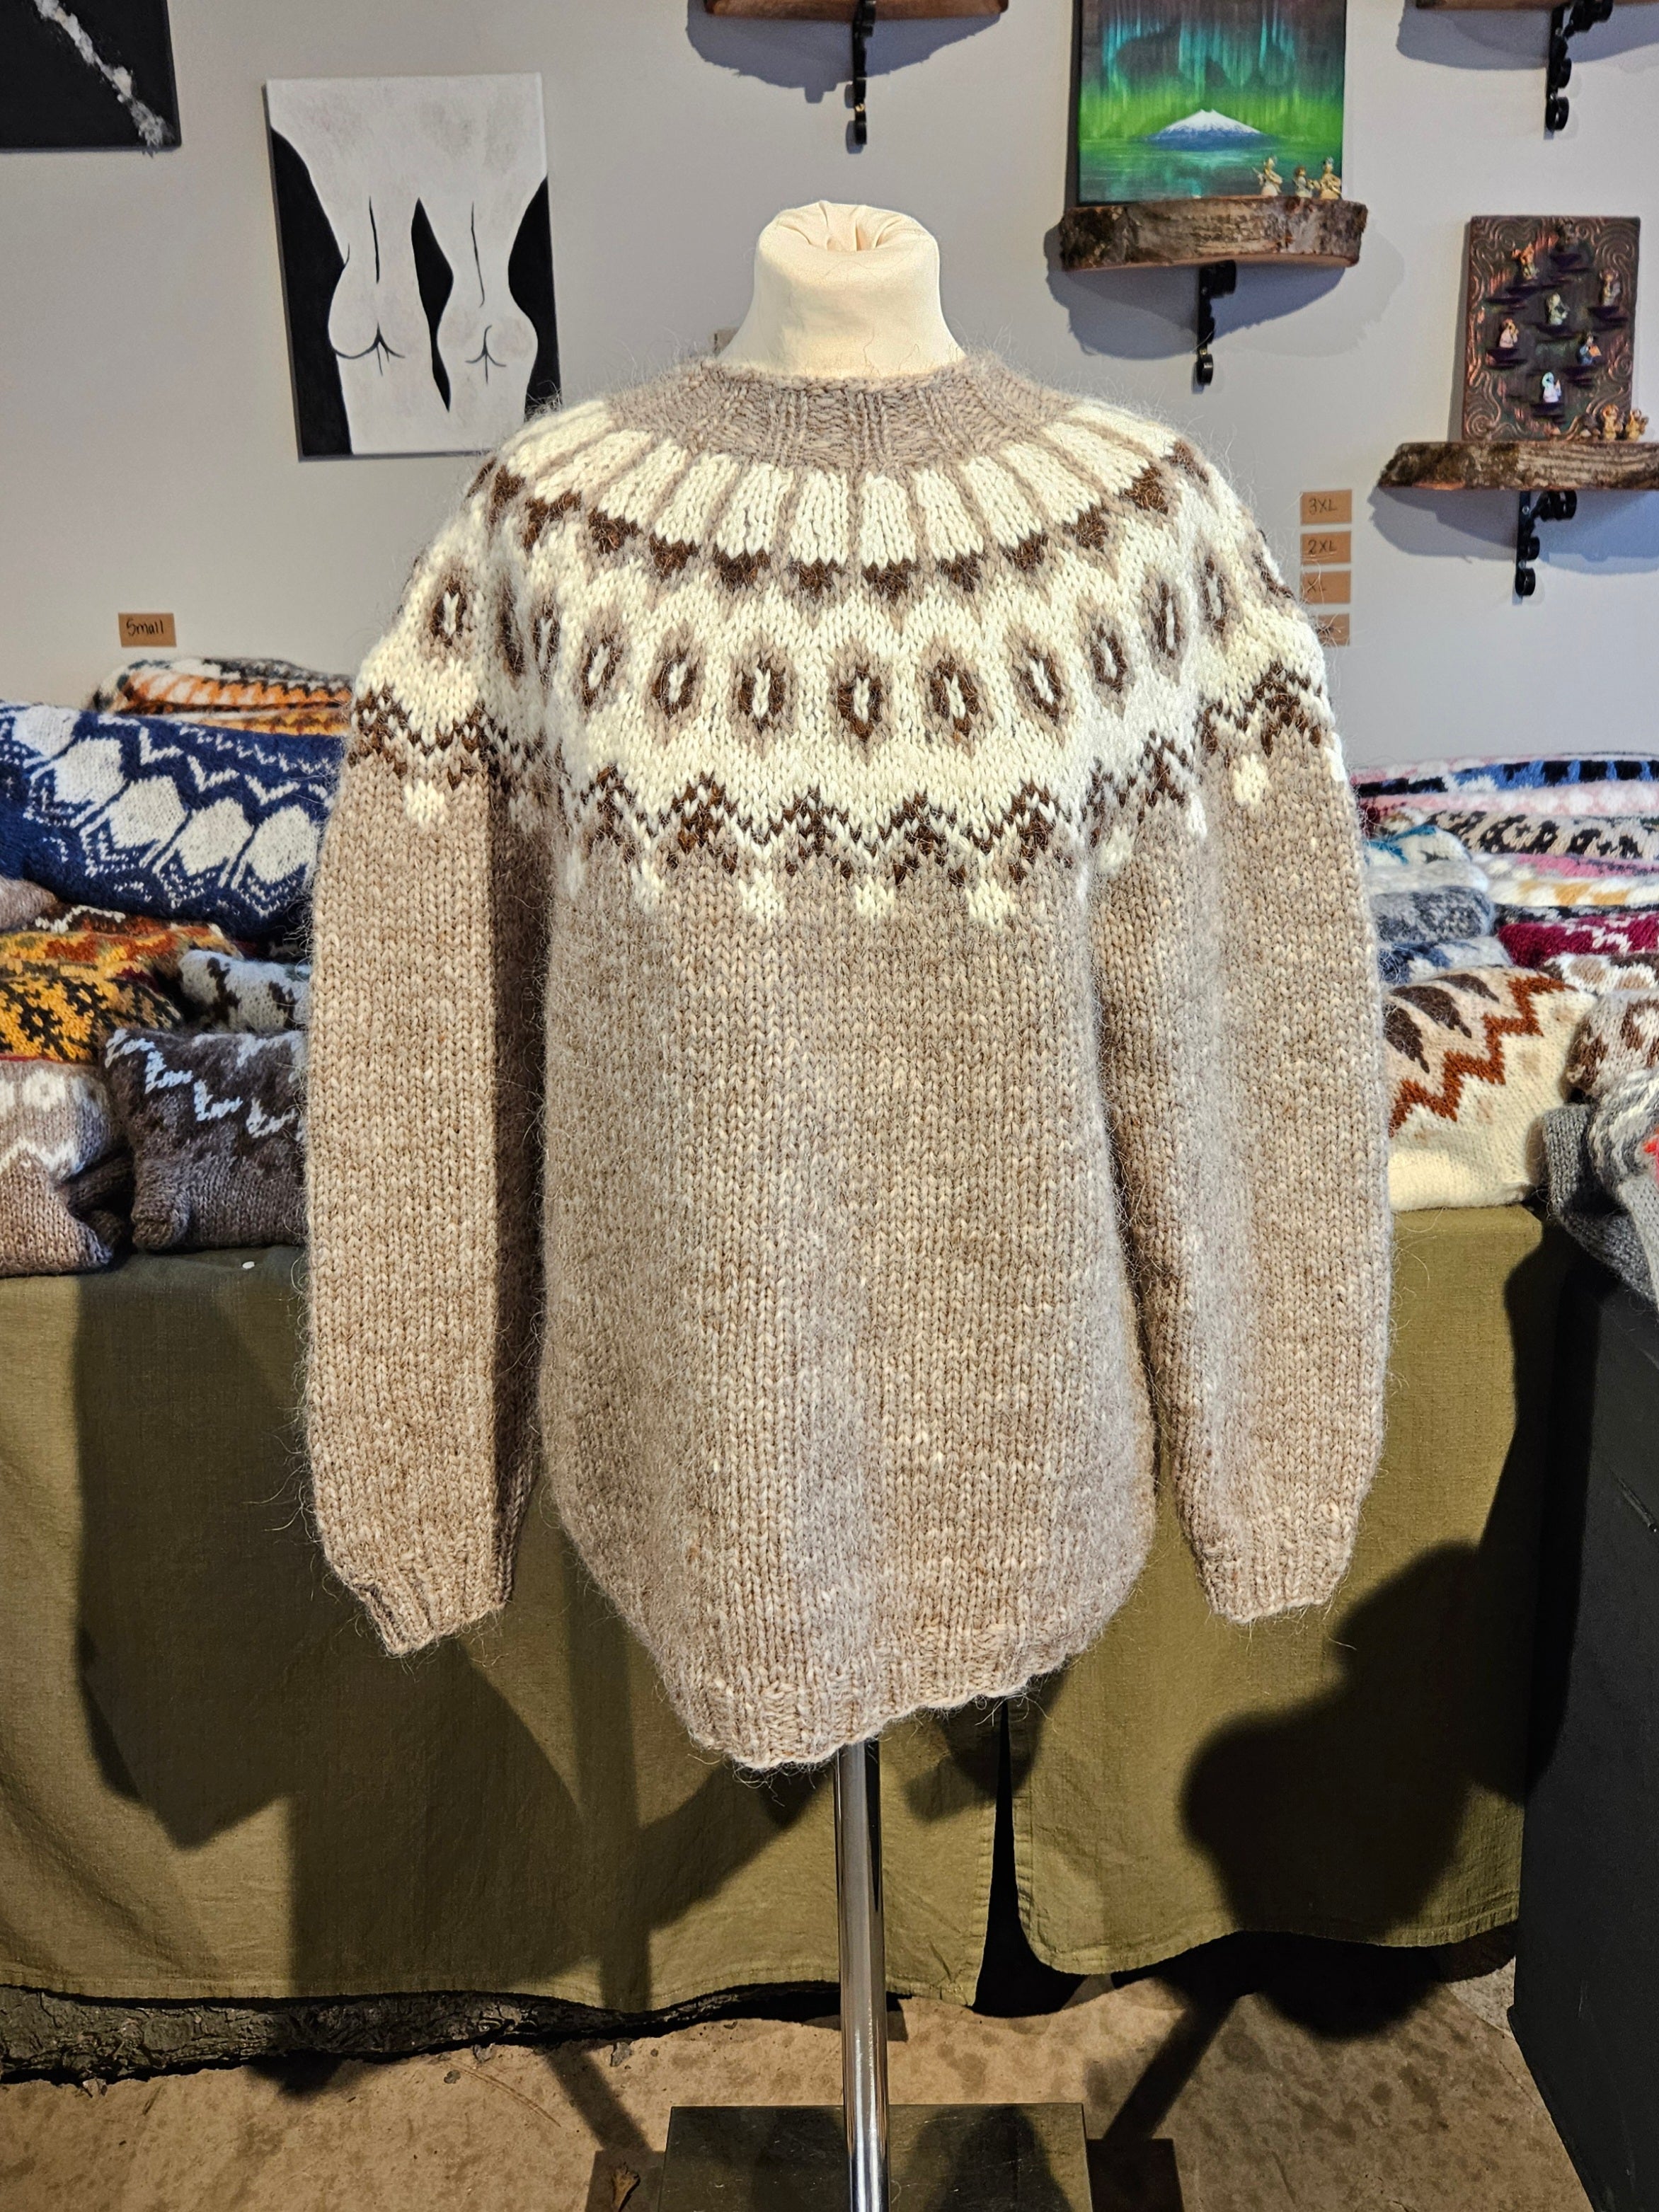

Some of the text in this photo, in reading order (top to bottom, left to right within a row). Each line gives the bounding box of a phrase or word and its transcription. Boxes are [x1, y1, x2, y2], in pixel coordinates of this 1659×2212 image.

[1308, 497, 1338, 516] 3XL
[1307, 538, 1337, 555] 2XL
[126, 617, 164, 637] Small
